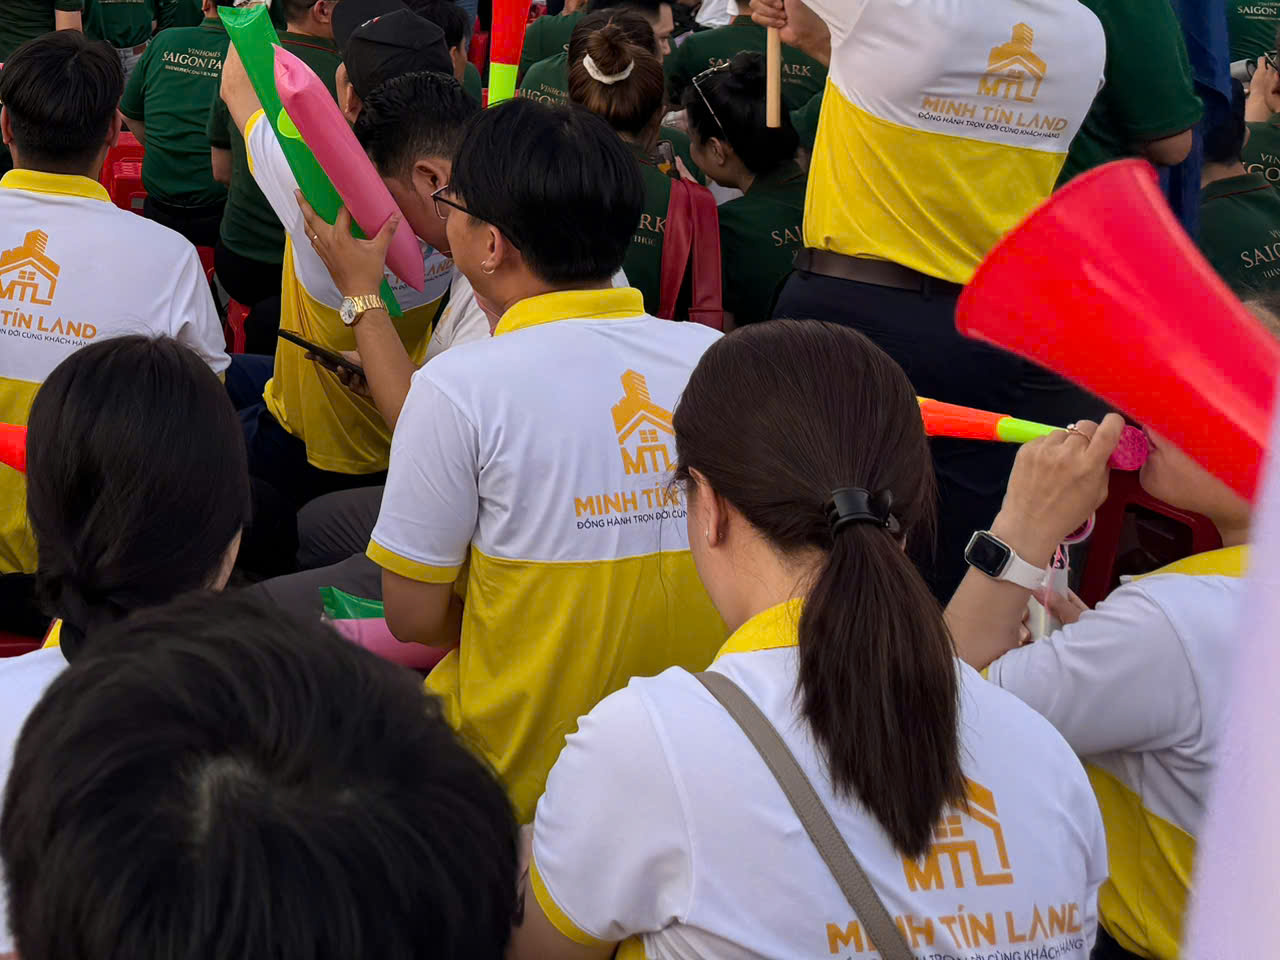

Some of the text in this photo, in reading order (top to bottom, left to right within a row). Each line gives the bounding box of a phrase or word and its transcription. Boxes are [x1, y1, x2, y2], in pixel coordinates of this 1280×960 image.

[1237, 5, 1277, 16] SAIGON
[162, 51, 223, 70] SAIGON PA
[783, 64, 811, 77] ARK
[923, 95, 1069, 132] MINH TÍN LAND
[771, 226, 802, 247] SAI
[0, 308, 33, 329] TÍN
[37, 316, 97, 339] LAND
[574, 491, 638, 517] MINH
[577, 516, 605, 529] ĐỒNG
[607, 515, 632, 527] HÀNH
[633, 512, 654, 524] TRỌN
[902, 840, 1014, 891] MTL
[938, 904, 997, 950] TÍN
[1060, 938, 1084, 954] HÀNG
